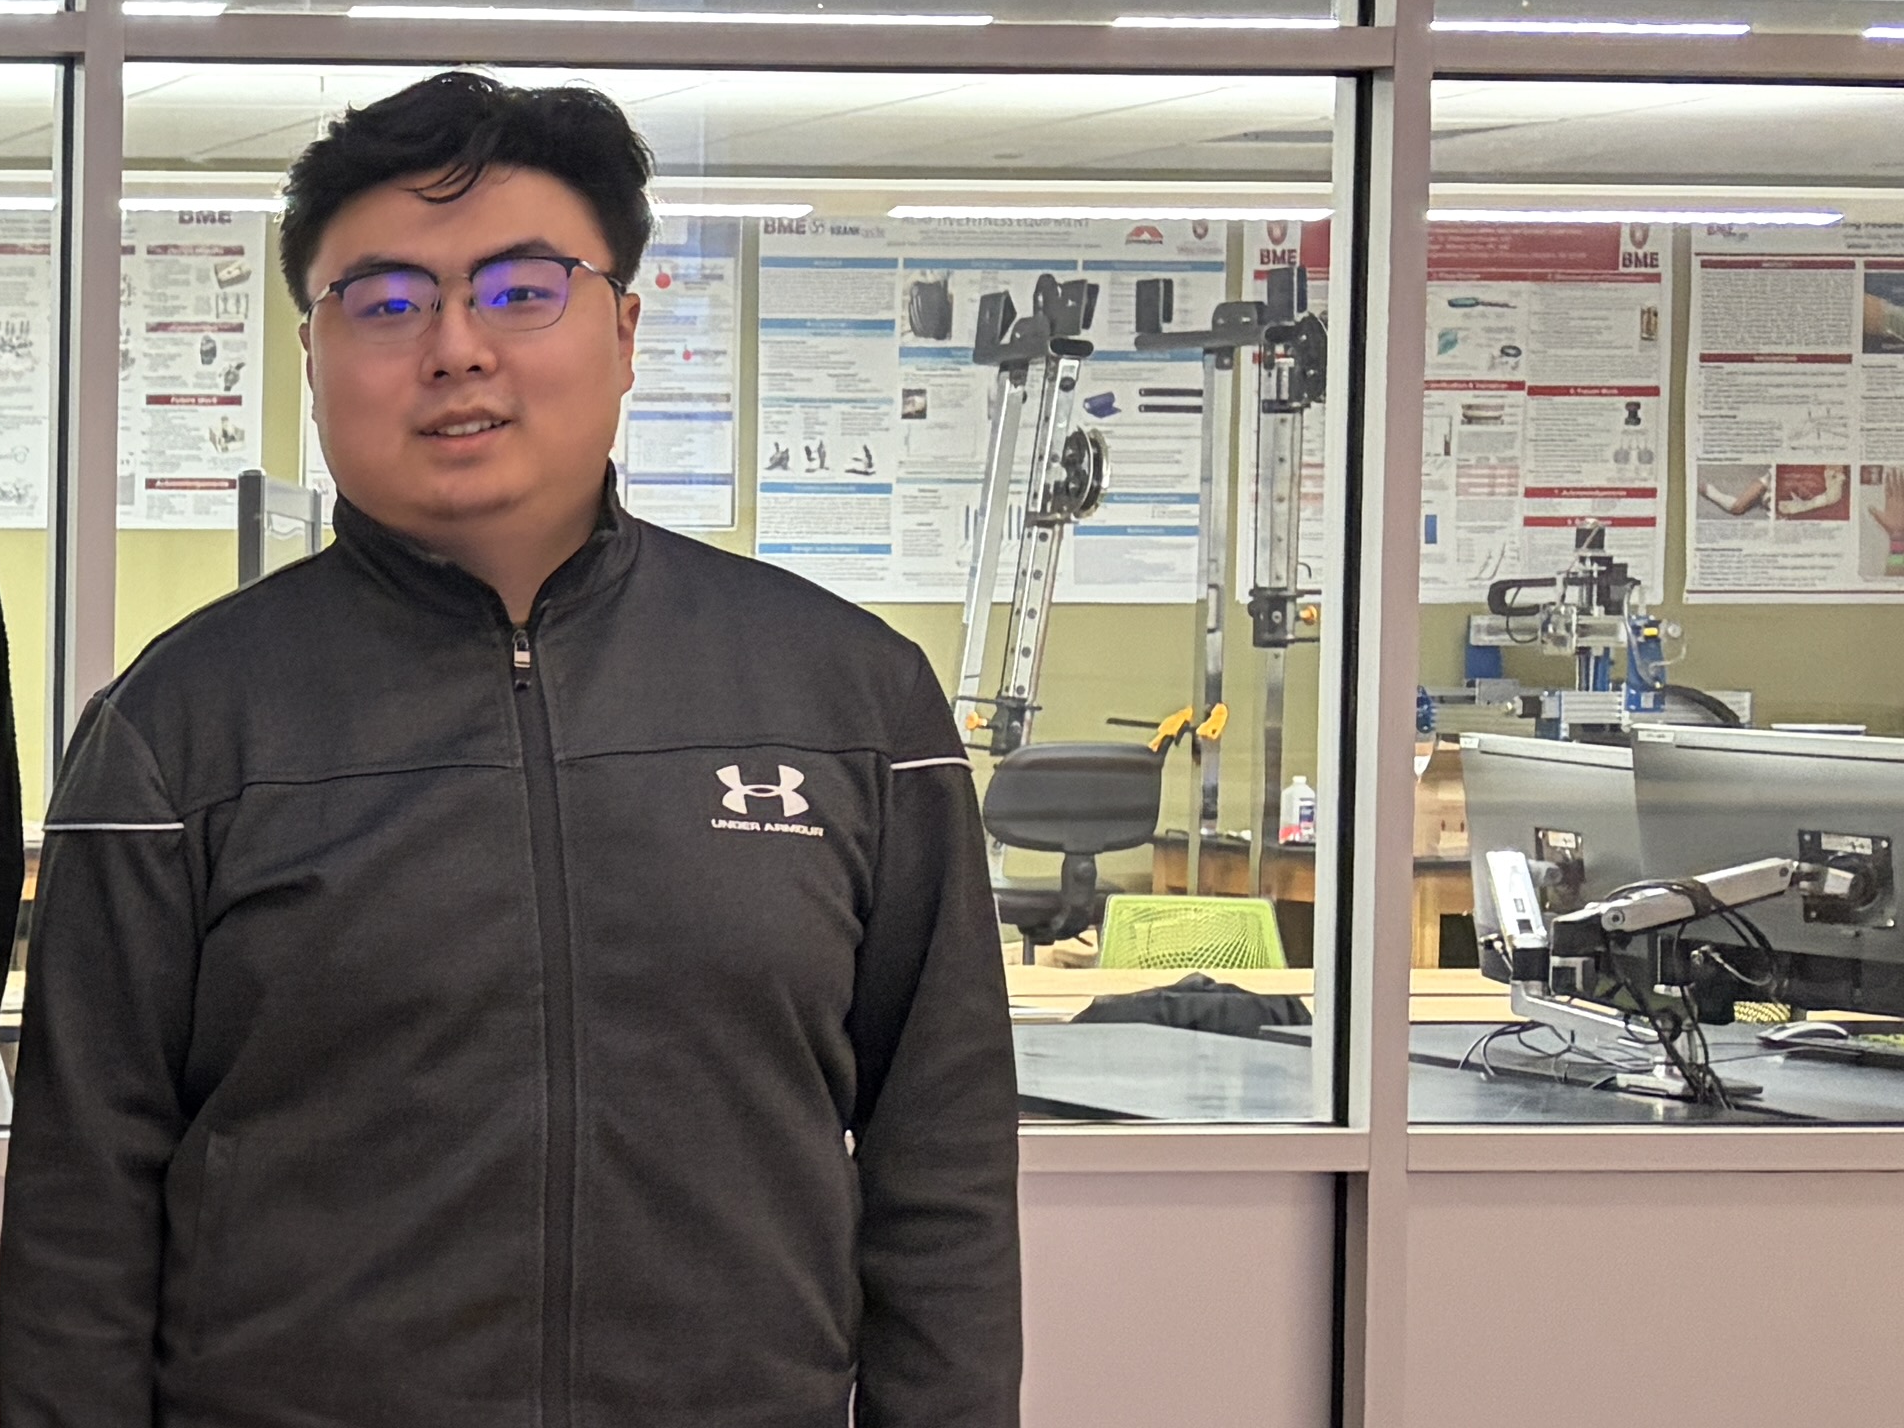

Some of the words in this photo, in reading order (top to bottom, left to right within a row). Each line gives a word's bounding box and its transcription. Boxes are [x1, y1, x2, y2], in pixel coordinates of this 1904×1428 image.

[763, 217, 806, 234] BME
[1259, 249, 1297, 265] BME
[1622, 251, 1659, 268] BME
[711, 818, 761, 832] UNDER
[764, 821, 824, 837] ARMOUR
